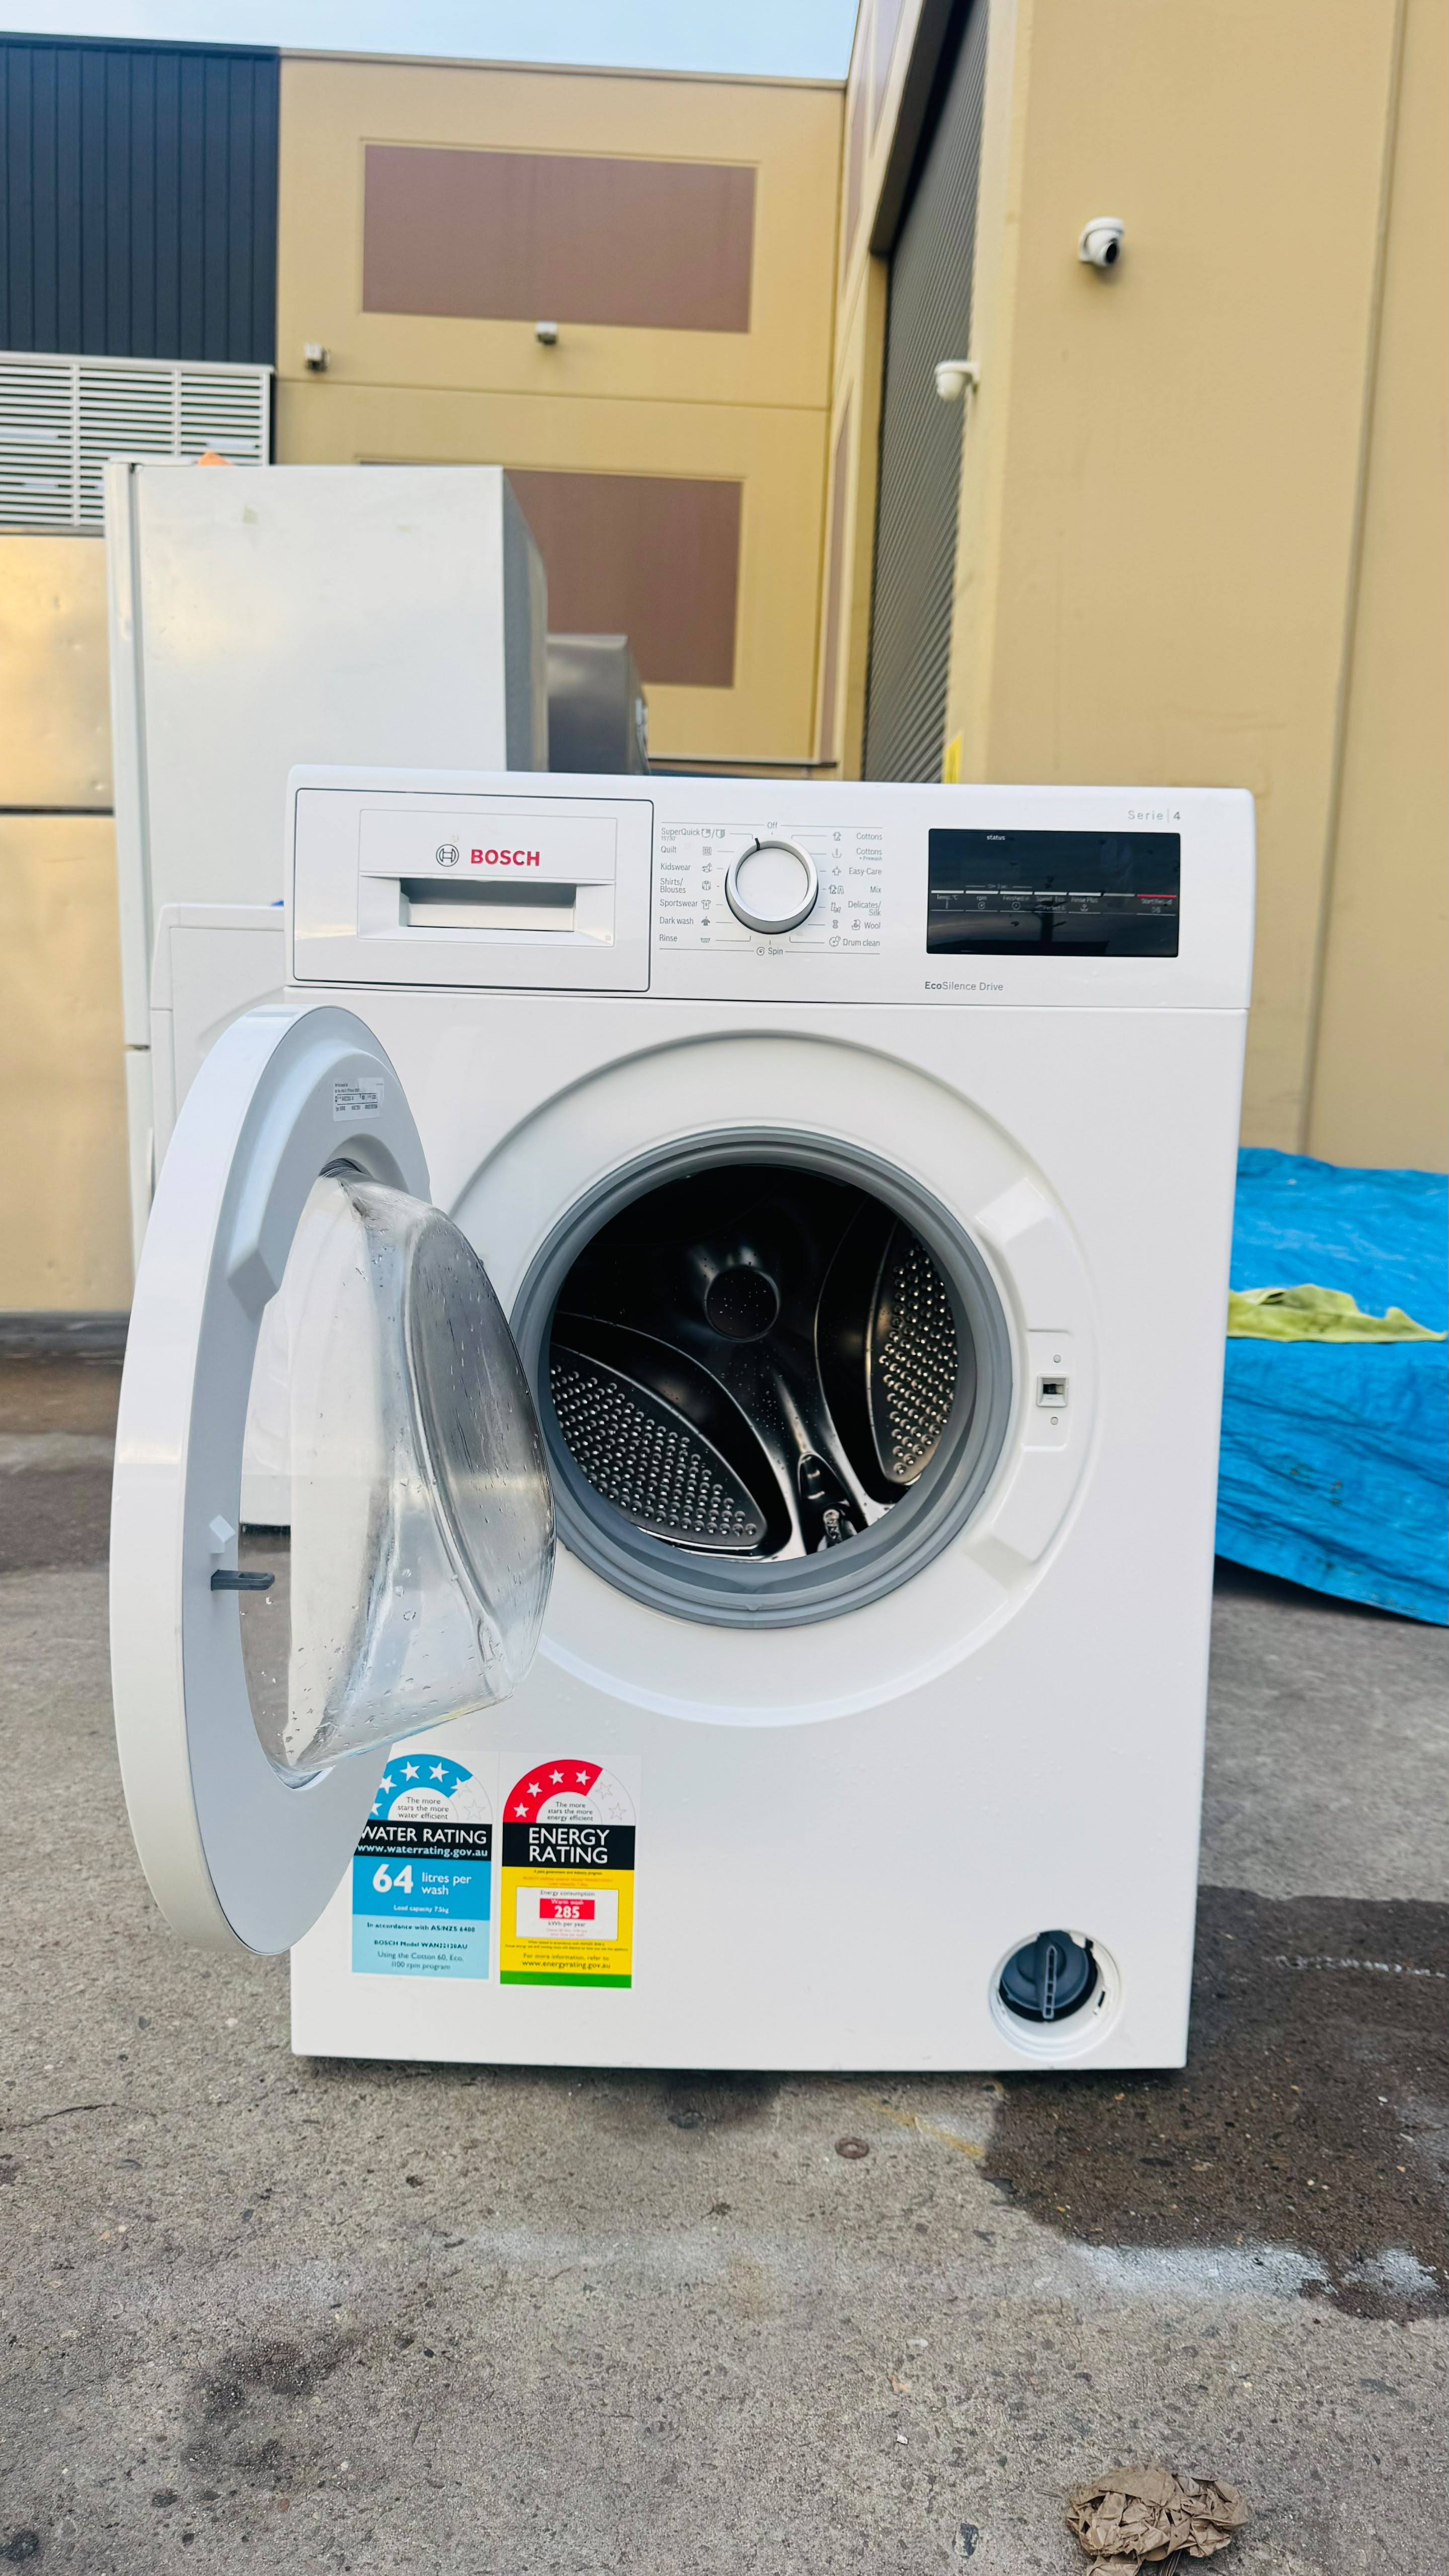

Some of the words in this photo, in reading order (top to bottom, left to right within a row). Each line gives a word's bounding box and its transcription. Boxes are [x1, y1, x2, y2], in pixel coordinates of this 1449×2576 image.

[1128, 810, 1163, 820] Serie
[661, 828, 700, 837] SuperQuick
[856, 847, 882, 855] Cottons
[470, 849, 540, 866] BOSCH
[660, 878, 683, 887] Shirts/
[660, 899, 698, 907] Sportswear
[848, 901, 881, 910] Delicates/
[843, 938, 861, 946] Drum
[768, 947, 783, 956] Spin
[925, 981, 976, 990] EcoSilence
[979, 982, 1003, 991] Drive
[361, 1826, 418, 1842] WATER
[423, 1828, 487, 1844] RATING
[529, 1827, 610, 1845] ENERGY
[357, 1844, 488, 1858] www.waterrating.gov.au
[529, 1845, 608, 1864] RATING
[372, 1864, 414, 1894] 64
[422, 1872, 449, 1883] litres
[453, 1876, 472, 1886] per
[421, 1885, 449, 1895] wash
[554, 1905, 580, 1919] 285
[378, 1951, 396, 1959] Using
[522, 1961, 610, 1970] www.energyrating.gov.au
